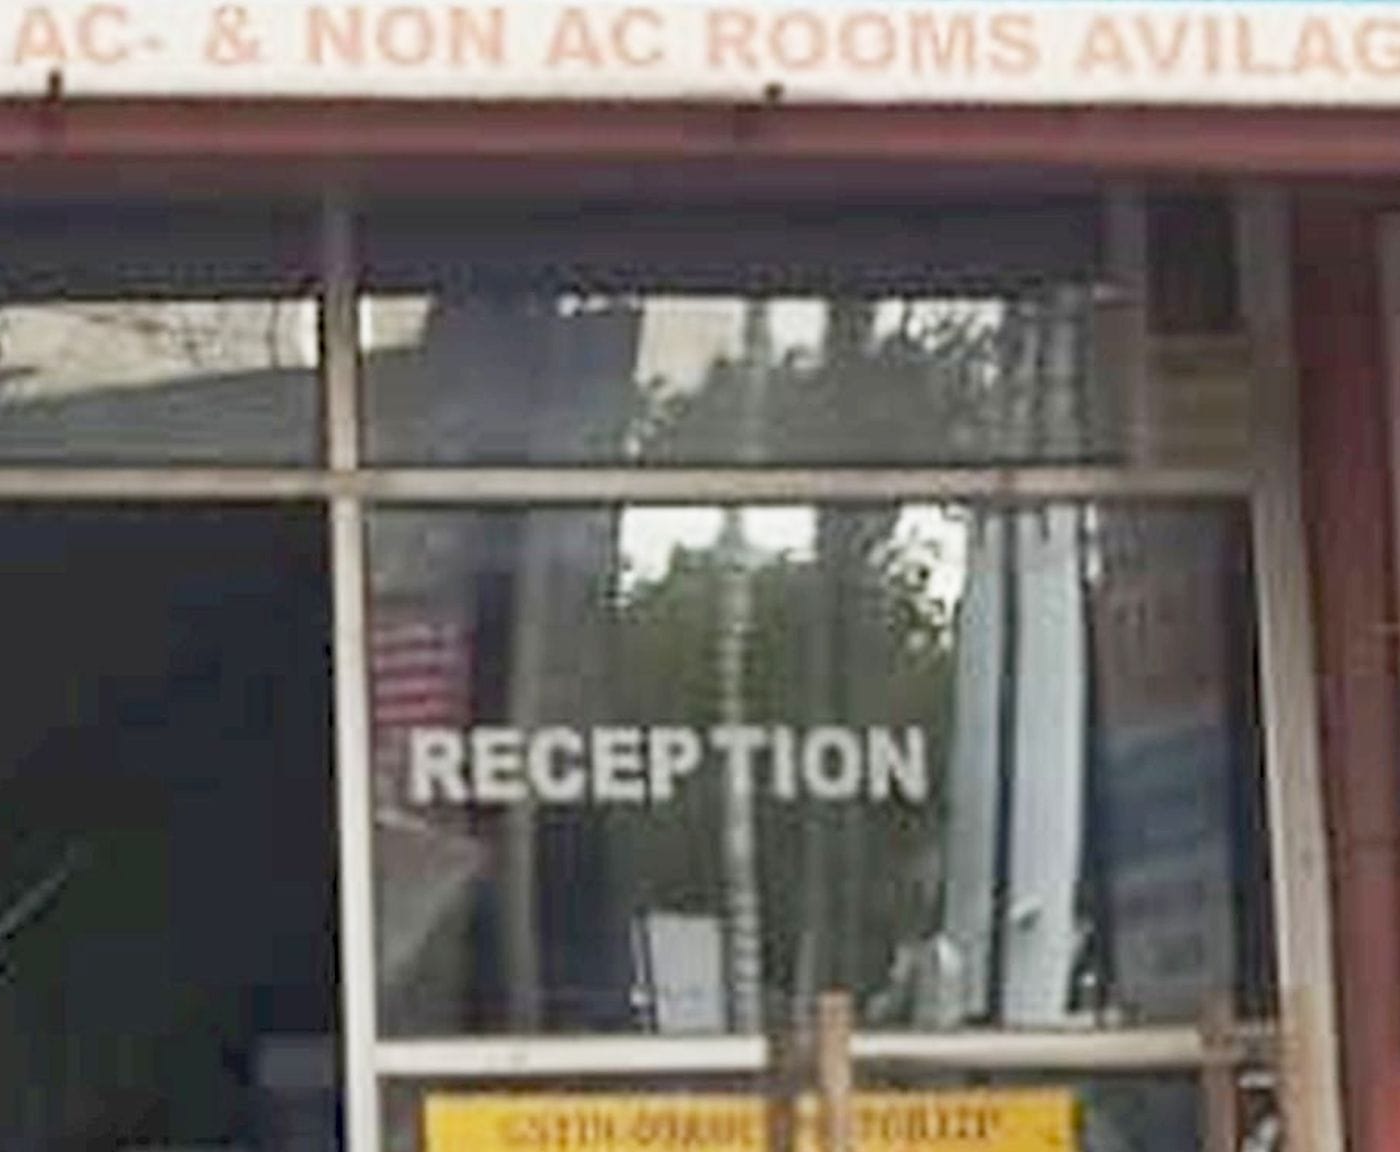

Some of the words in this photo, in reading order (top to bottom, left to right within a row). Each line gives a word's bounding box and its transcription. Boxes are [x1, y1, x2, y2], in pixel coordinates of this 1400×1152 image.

[204, 5, 261, 65] &
[304, 6, 505, 66] NON
[544, 7, 665, 68] AC
[706, 12, 1041, 74] ROOMS
[408, 725, 928, 801] RECEPTION
